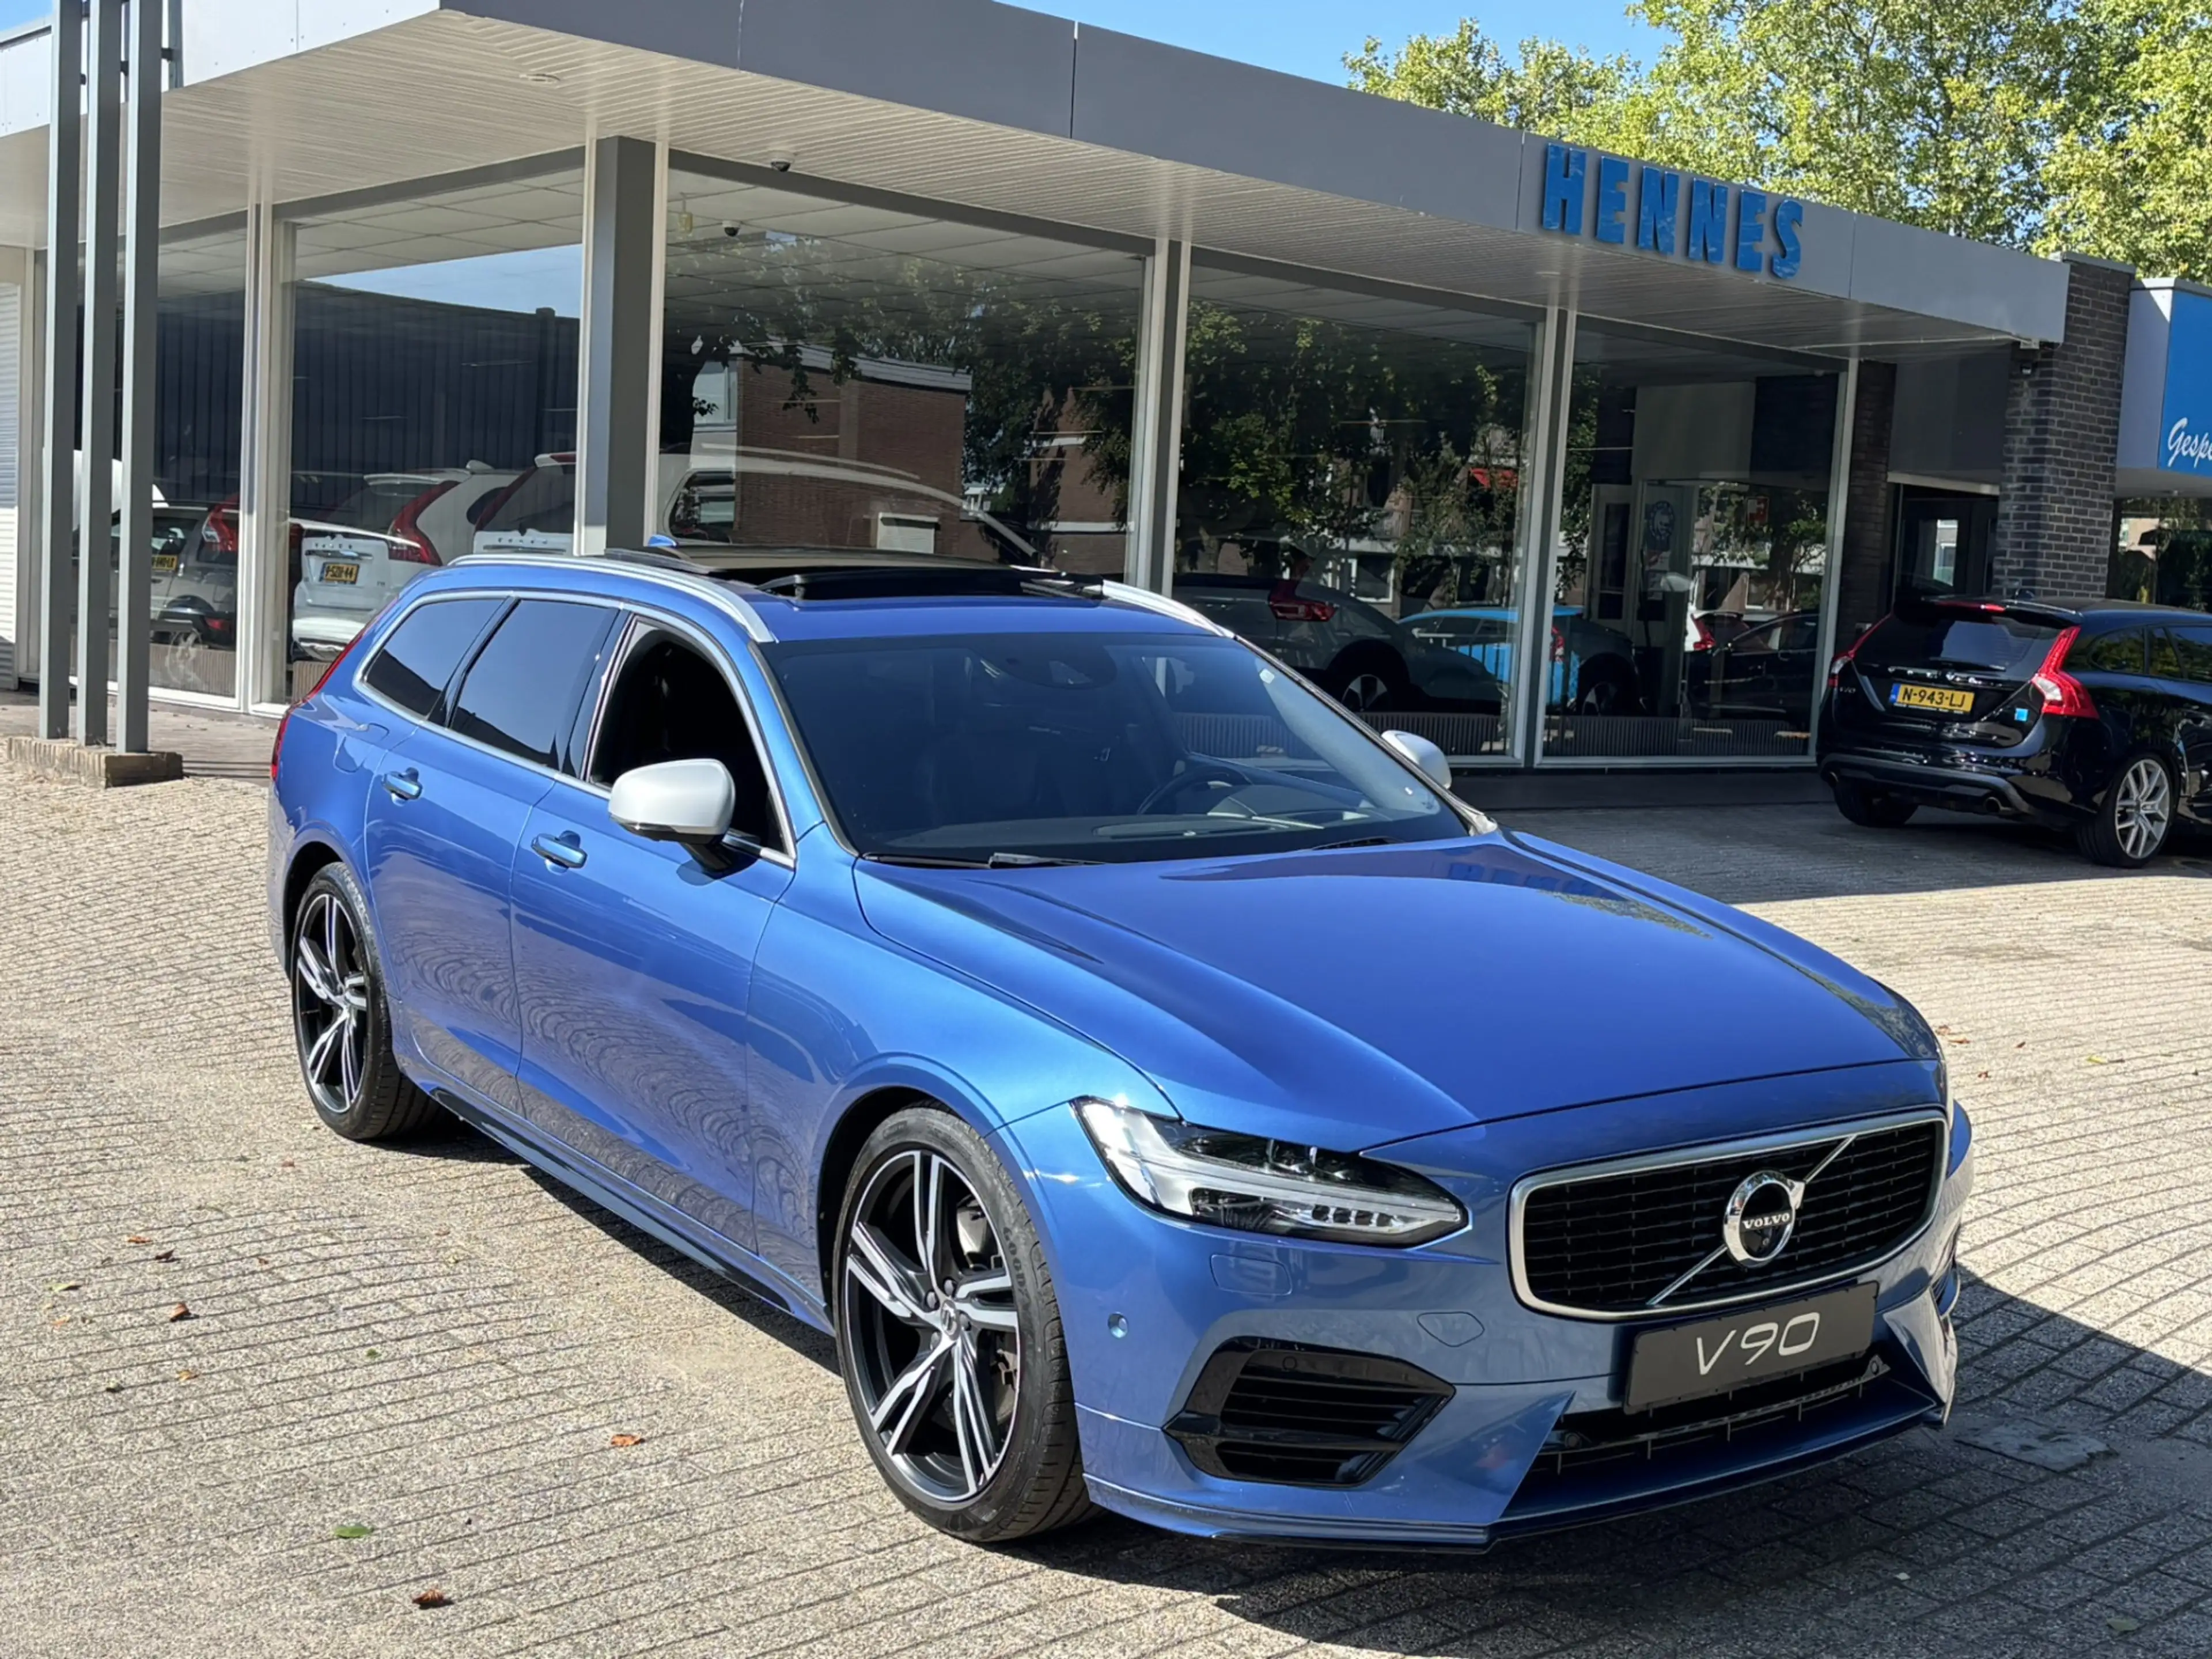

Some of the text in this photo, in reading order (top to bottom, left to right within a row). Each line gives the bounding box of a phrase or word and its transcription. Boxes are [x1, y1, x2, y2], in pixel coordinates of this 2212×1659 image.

[1541, 142, 1803, 279] HENNES
[1902, 687, 1966, 708] N-943-LJ
[1742, 1213, 1790, 1229] VOLVO
